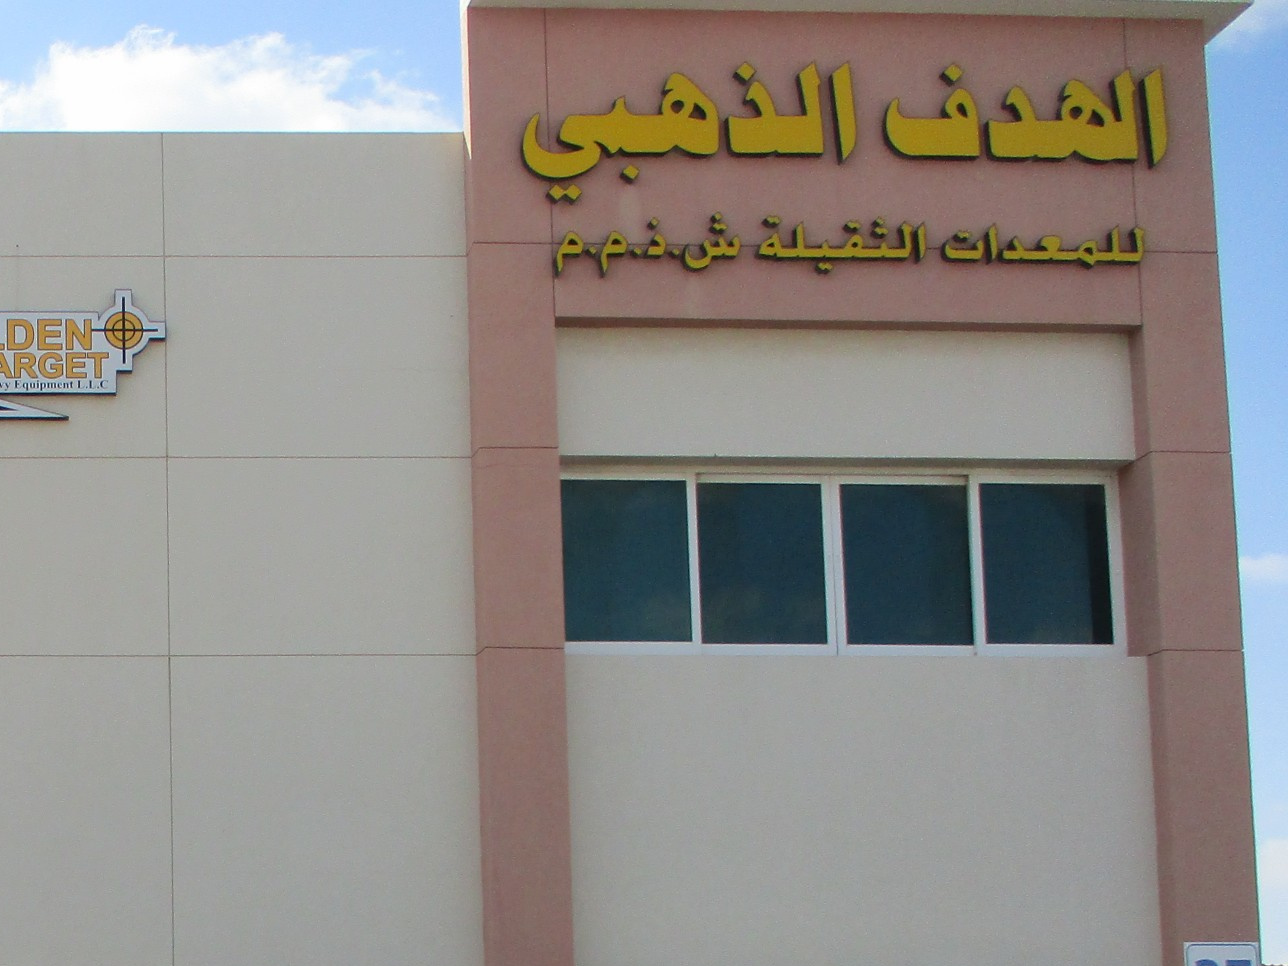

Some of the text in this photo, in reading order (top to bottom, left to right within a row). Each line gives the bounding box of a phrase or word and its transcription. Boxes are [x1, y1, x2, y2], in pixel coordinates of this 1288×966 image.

[521, 60, 1169, 204] الهدف الذهبي
[755, 214, 926, 275] الثقيلة
[941, 223, 1145, 269] للمعدات
[14, 379, 74, 391] Equipment
[77, 379, 109, 390] L.L.C
